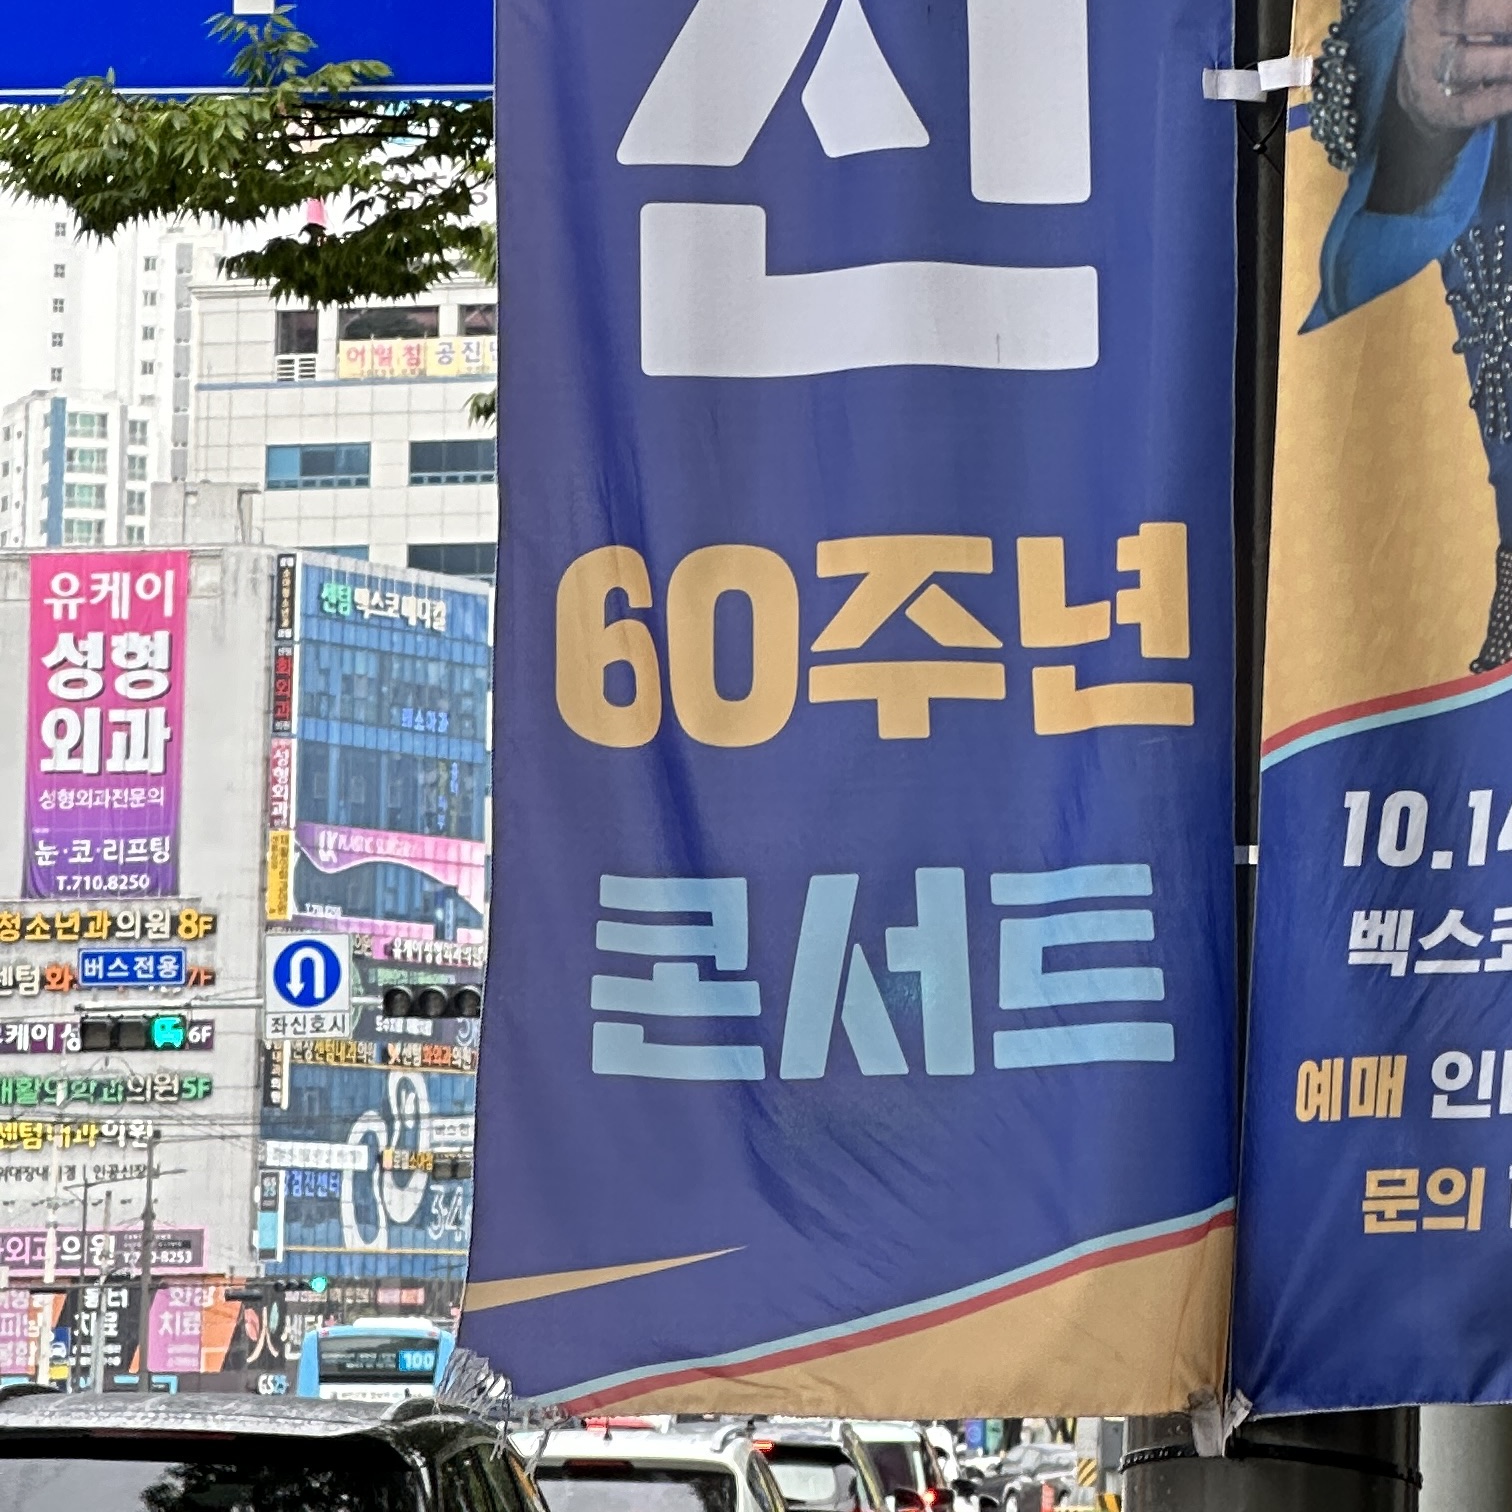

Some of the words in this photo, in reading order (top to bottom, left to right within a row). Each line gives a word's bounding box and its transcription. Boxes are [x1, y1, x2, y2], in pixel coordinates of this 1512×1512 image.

[43, 569, 175, 620] 유케이
[555, 522, 1195, 748] 60주년
[41, 630, 172, 701] 성형
[39, 706, 173, 775] 외과
[38, 786, 165, 810] 성형외과전문의
[56, 874, 151, 891] T.710.8250
[177, 907, 214, 941] 8F
[83, 954, 181, 980] 버스전용
[590, 863, 1175, 1081] 콘서트
[187, 1026, 213, 1044] 6F
[270, 1014, 347, 1035] 좌신호시
[181, 1074, 213, 1103] 5F
[1294, 1053, 1407, 1123] 예매
[1361, 1166, 1487, 1234] 문의
[403, 1351, 436, 1368] 100
